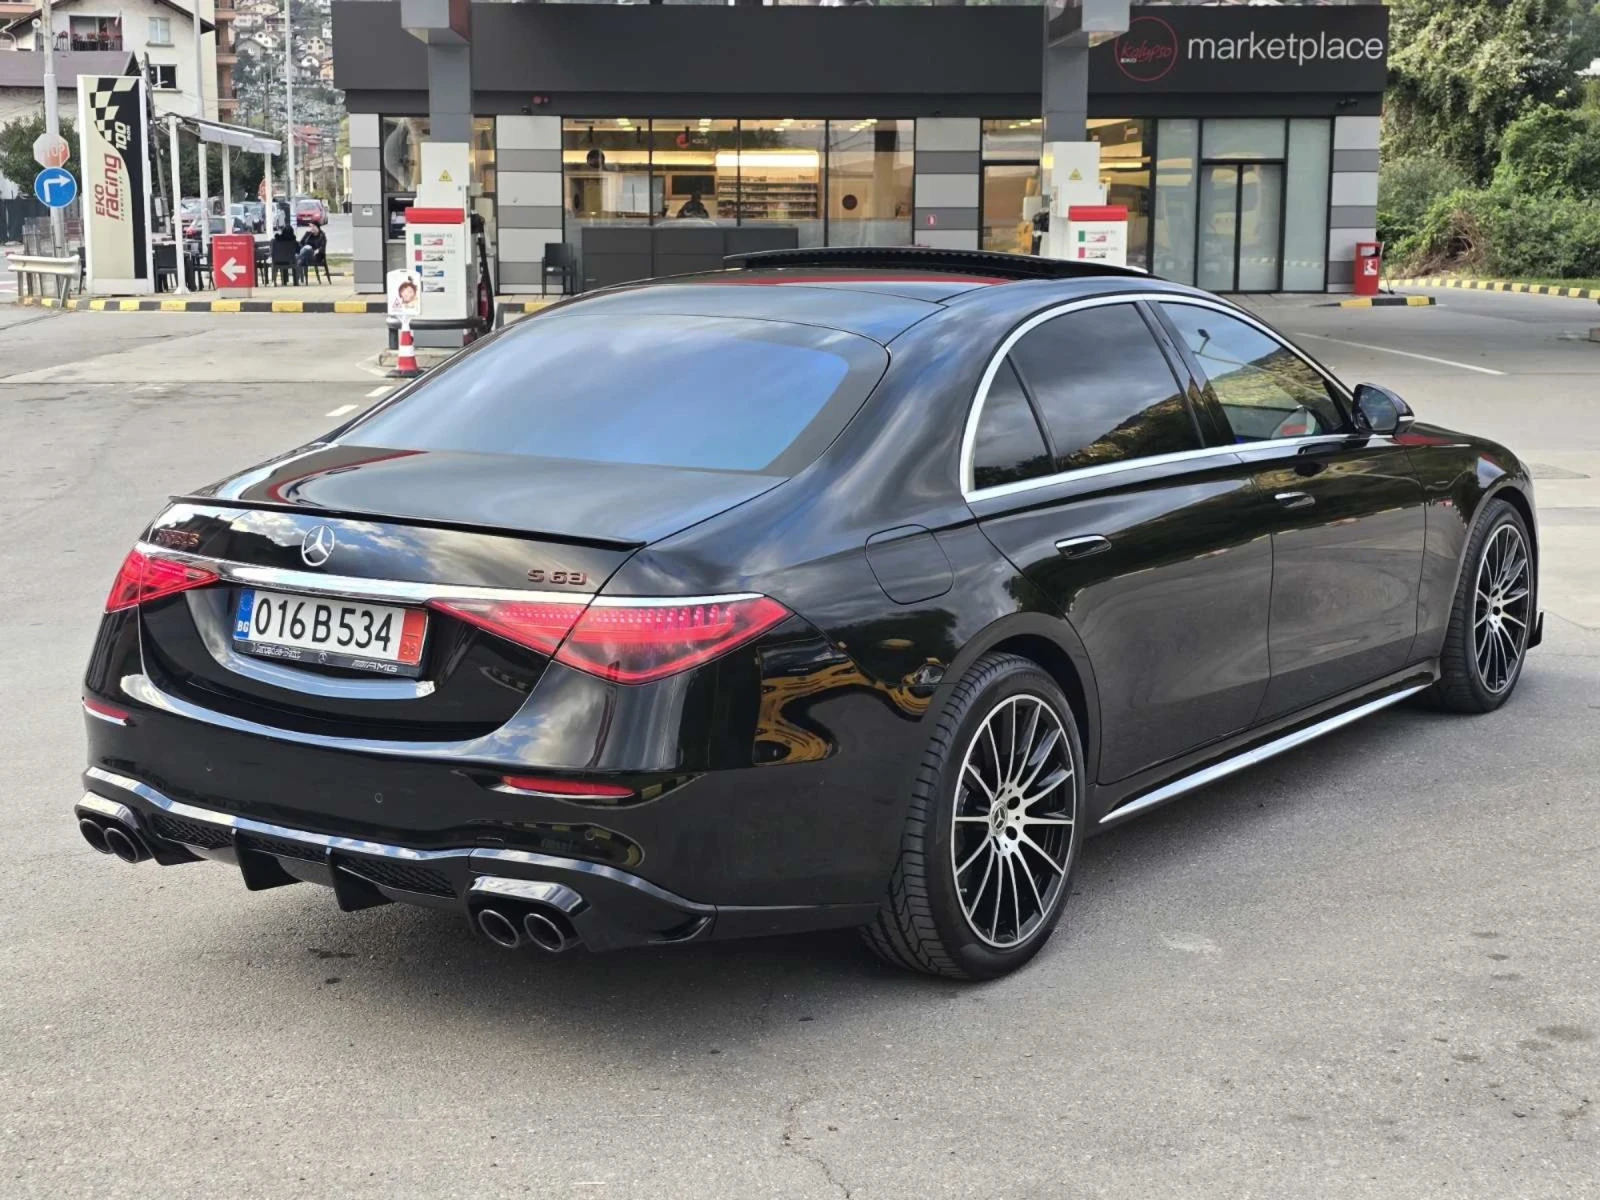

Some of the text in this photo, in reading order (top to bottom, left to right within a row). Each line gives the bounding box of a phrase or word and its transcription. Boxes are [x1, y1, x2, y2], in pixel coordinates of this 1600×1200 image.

[1188, 31, 1384, 66] marketplace
[114, 121, 127, 150] 100
[95, 184, 105, 216] EKO
[104, 153, 122, 220] racing
[527, 569, 588, 586] S 63
[237, 620, 250, 632] BG
[255, 598, 393, 652] 016B534
[365, 661, 399, 673] AMG
